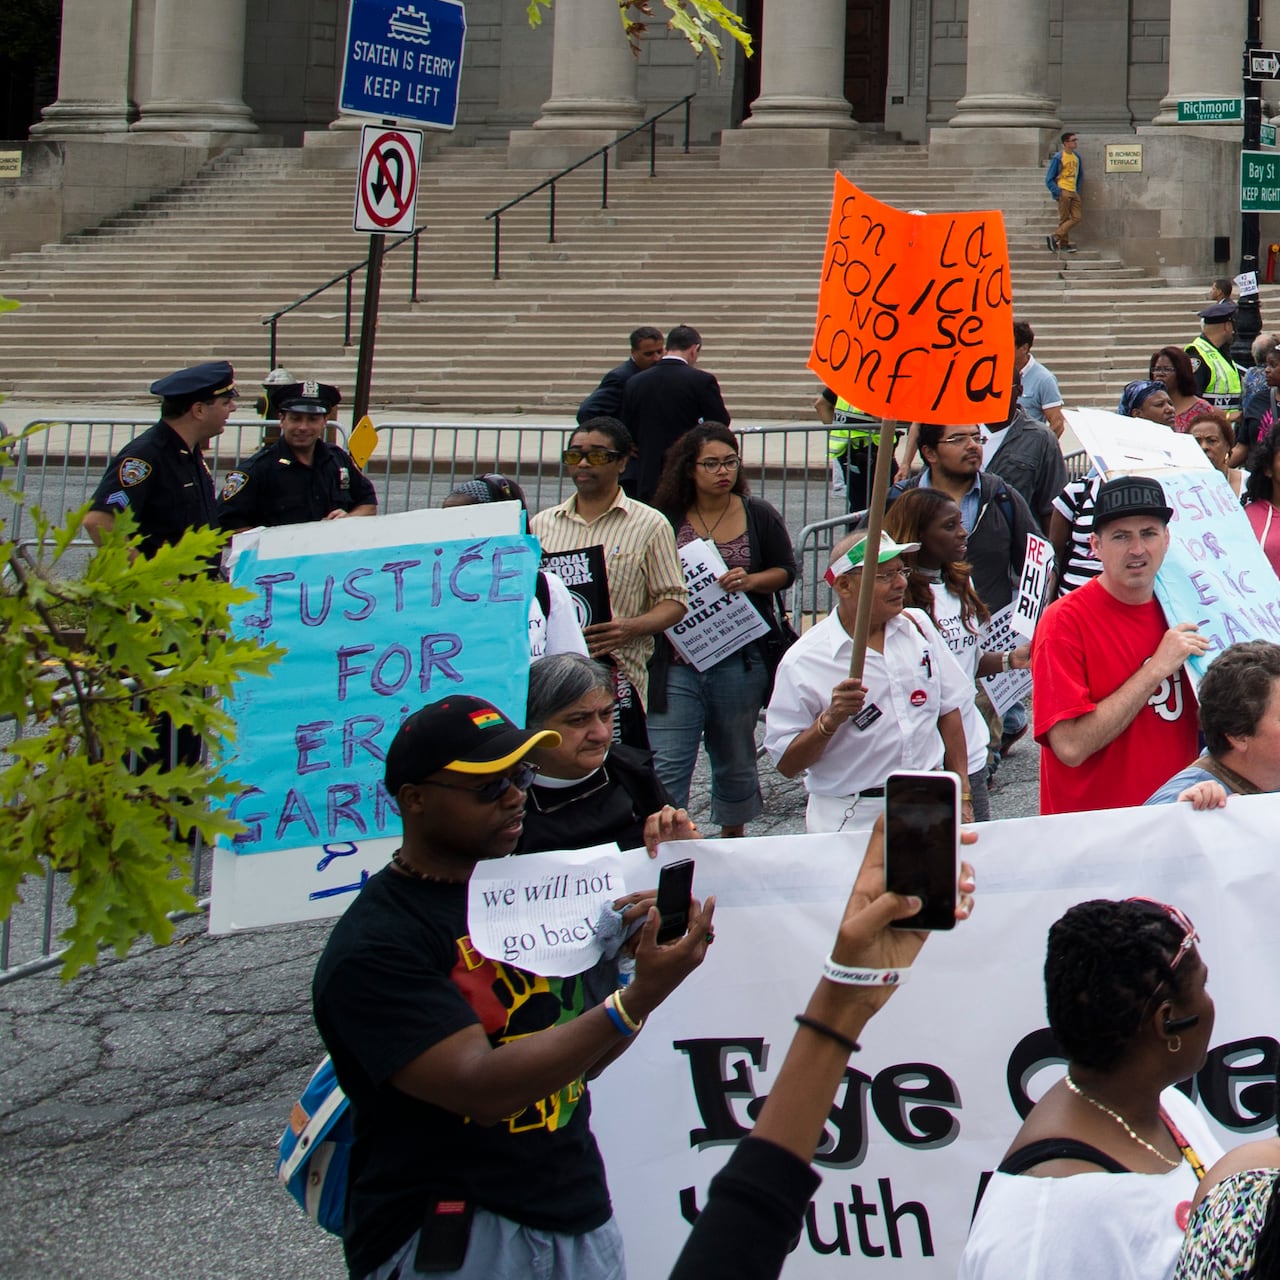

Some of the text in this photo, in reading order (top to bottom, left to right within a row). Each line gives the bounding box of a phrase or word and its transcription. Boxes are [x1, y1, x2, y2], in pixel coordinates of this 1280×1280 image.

[353, 40, 456, 79] STATEN IS FERRY
[363, 74, 441, 108] KEEP LEFT
[1183, 100, 1235, 115] Richmond
[1249, 162, 1276, 183] Bay St
[1242, 187, 1280, 202] KEEP RIGHT
[838, 196, 887, 257] En
[849, 298, 900, 342] NO
[1100, 487, 1161, 510] ADIDAS
[672, 591, 741, 636] GUILTY!
[691, 597, 705, 611] IS
[682, 633, 704, 649] Justice
[702, 625, 714, 637] for
[713, 617, 727, 631] Eric
[725, 603, 749, 621] Garner!
[688, 642, 709, 658] Justice
[710, 635, 723, 648] for
[719, 625, 736, 640] Mike
[734, 613, 757, 630] Brown!
[335, 632, 464, 702] FOR
[482, 871, 614, 909] we will not
[503, 932, 536, 962] go
[541, 917, 602, 946] back
